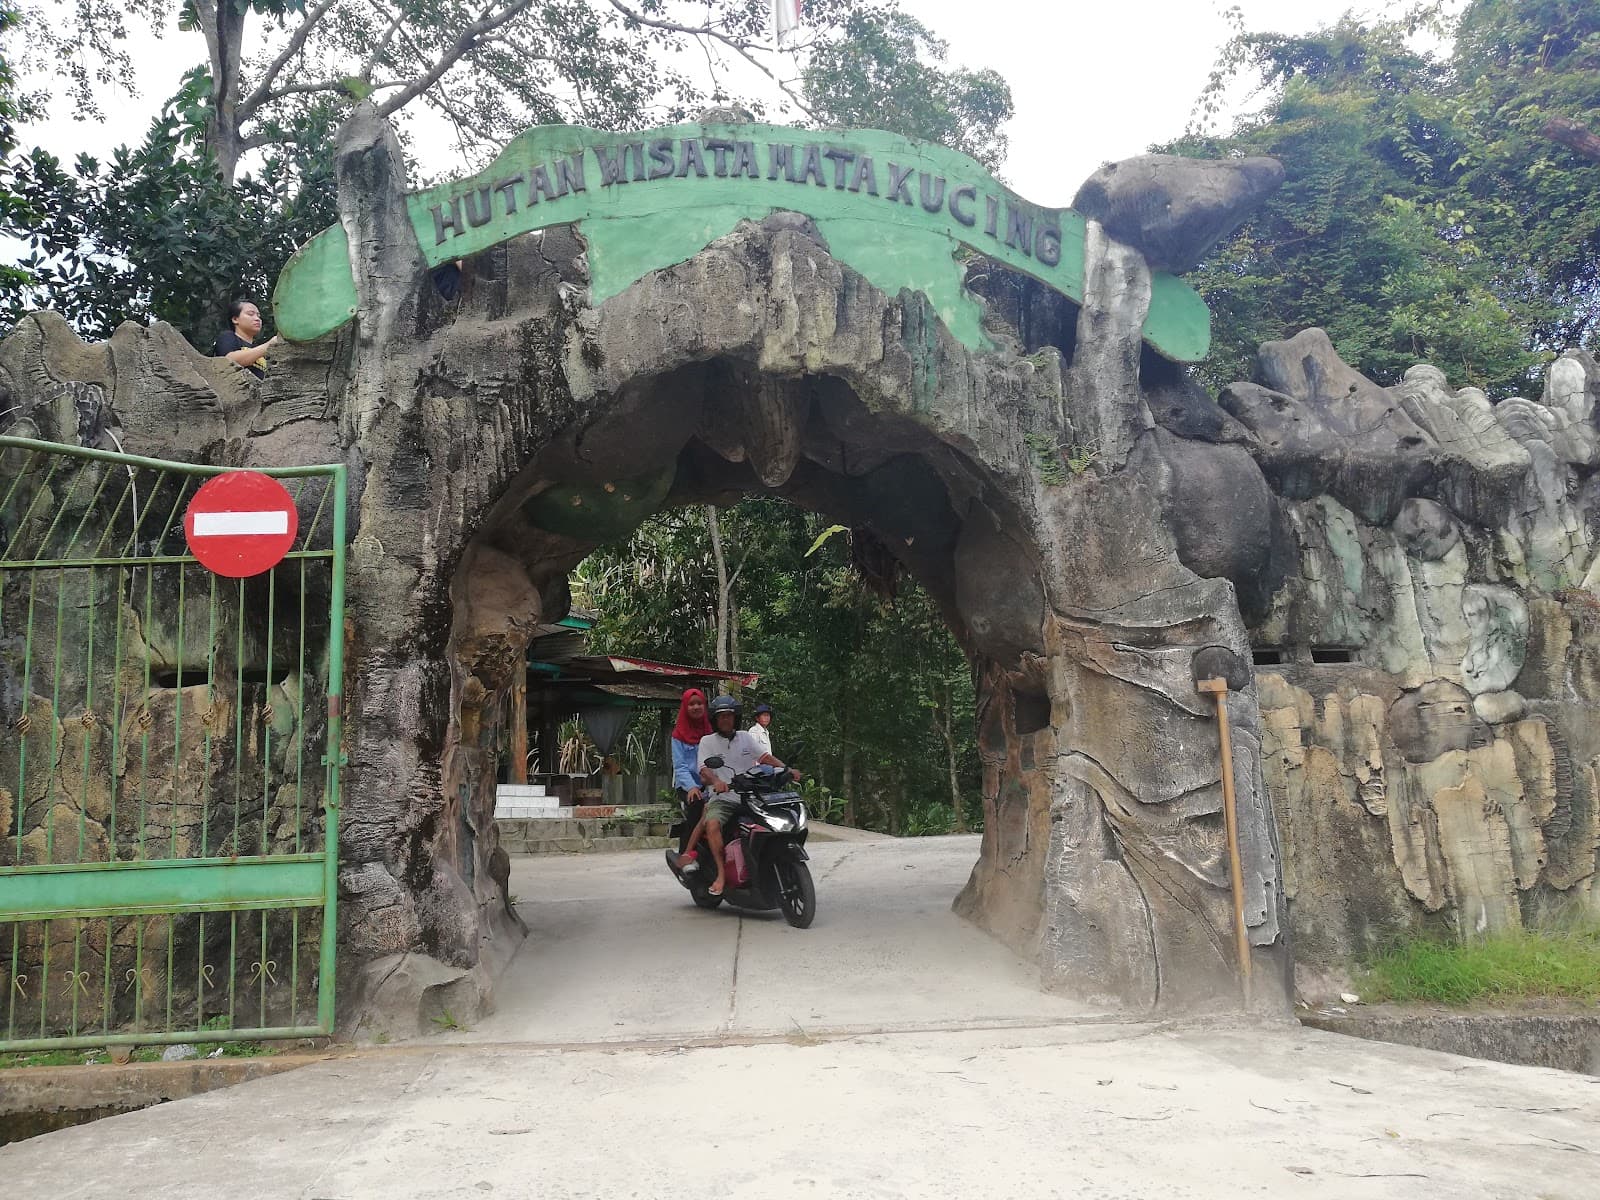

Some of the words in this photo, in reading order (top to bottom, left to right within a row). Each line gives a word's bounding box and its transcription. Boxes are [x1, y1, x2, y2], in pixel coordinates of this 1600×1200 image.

[430, 150, 586, 245] HUTAN
[593, 137, 759, 187] WISATA
[767, 143, 879, 196] MATA
[886, 160, 1061, 267] KUCING
